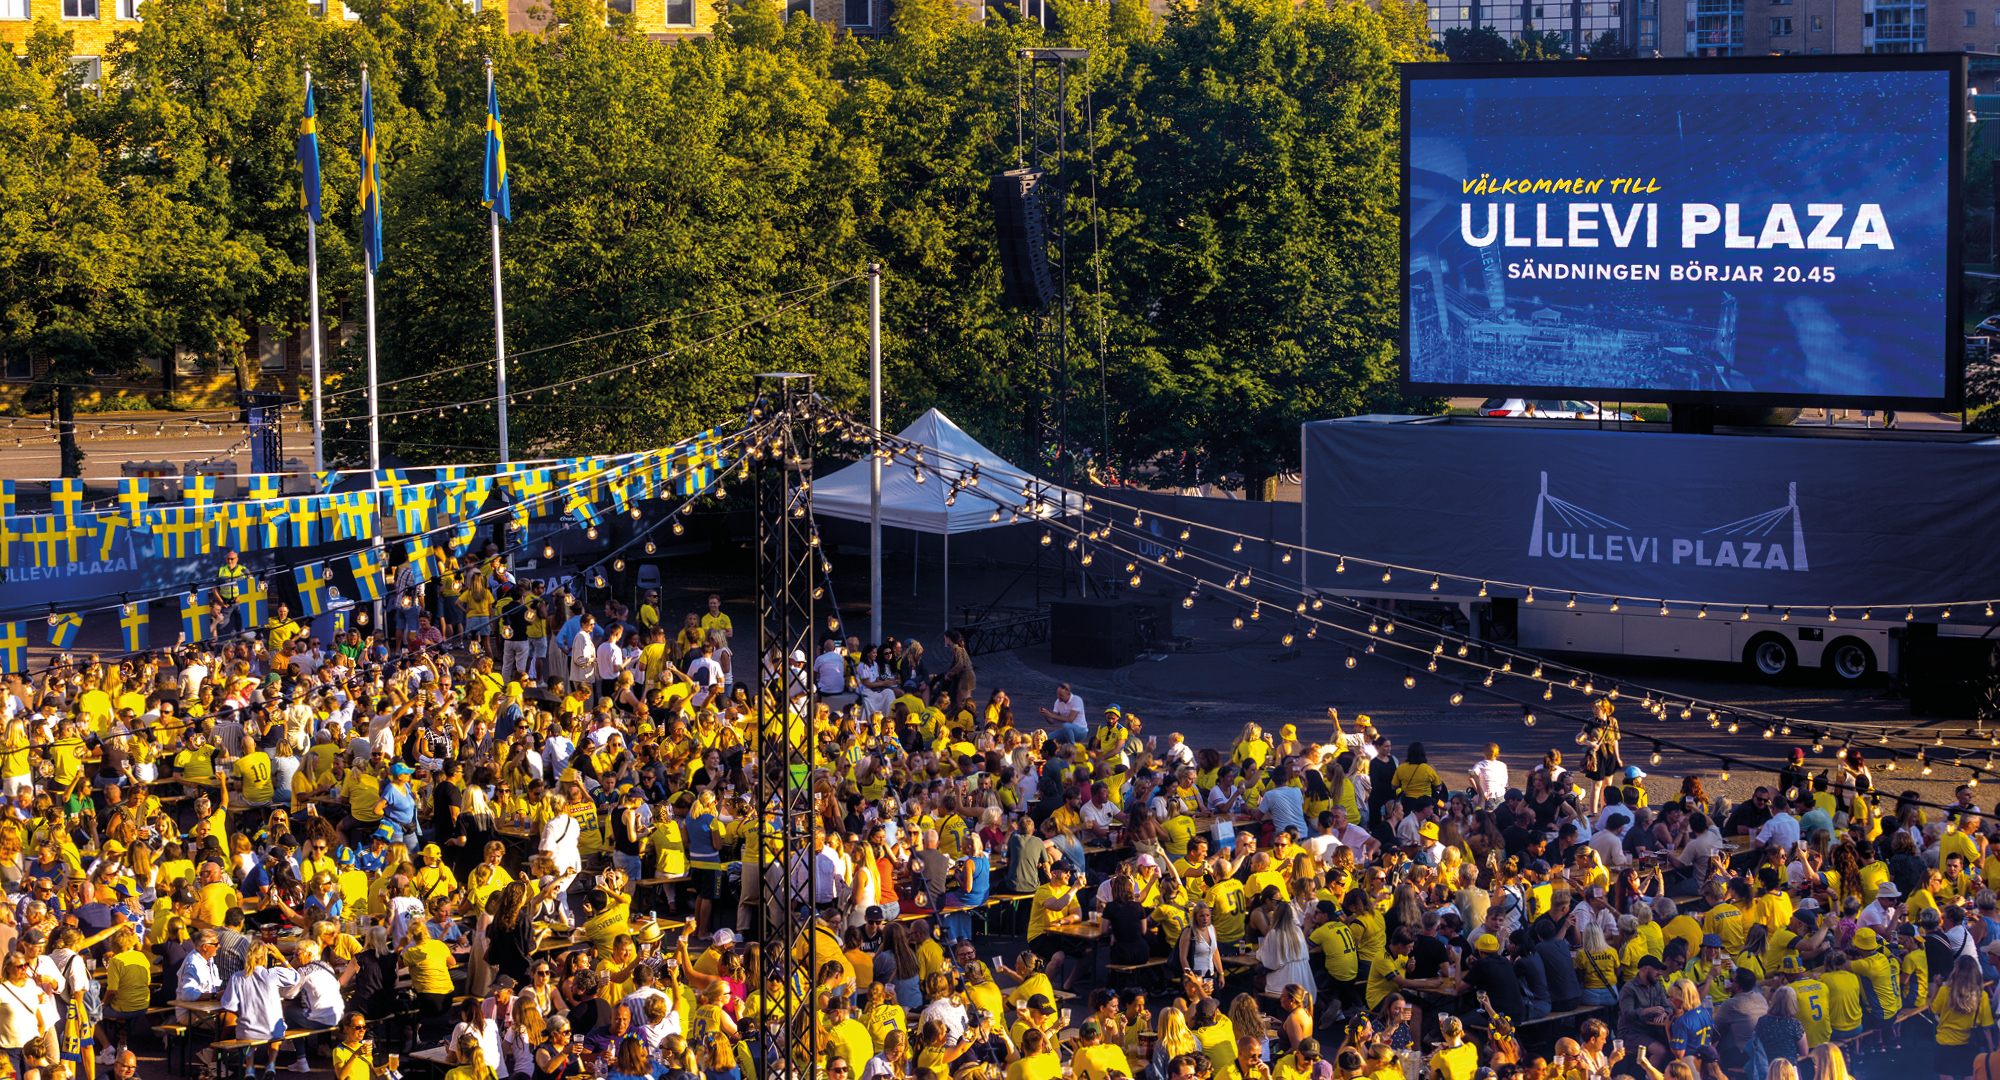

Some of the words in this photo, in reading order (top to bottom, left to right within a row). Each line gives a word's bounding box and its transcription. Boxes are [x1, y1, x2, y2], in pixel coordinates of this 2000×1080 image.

[1462, 174, 1604, 195] VÄLKOMMEN
[1611, 178, 1662, 194] TILL
[1461, 203, 1658, 248] ULLEVI
[1681, 203, 1895, 250] PLAZA
[1508, 258, 1660, 281] SÄNDNINGEN
[1670, 260, 1763, 282] BÖRJAR
[1773, 266, 1836, 283] 20.45
[1139, 541, 1178, 559] Ulle
[1547, 532, 1658, 564] ULLEVI
[1672, 538, 1790, 571] PLAZA
[66, 557, 129, 577] PLAZA
[251, 762, 268, 783] 10
[1226, 889, 1246, 916] 50
[1336, 927, 1356, 955] 10
[1808, 995, 1823, 1021] 5
